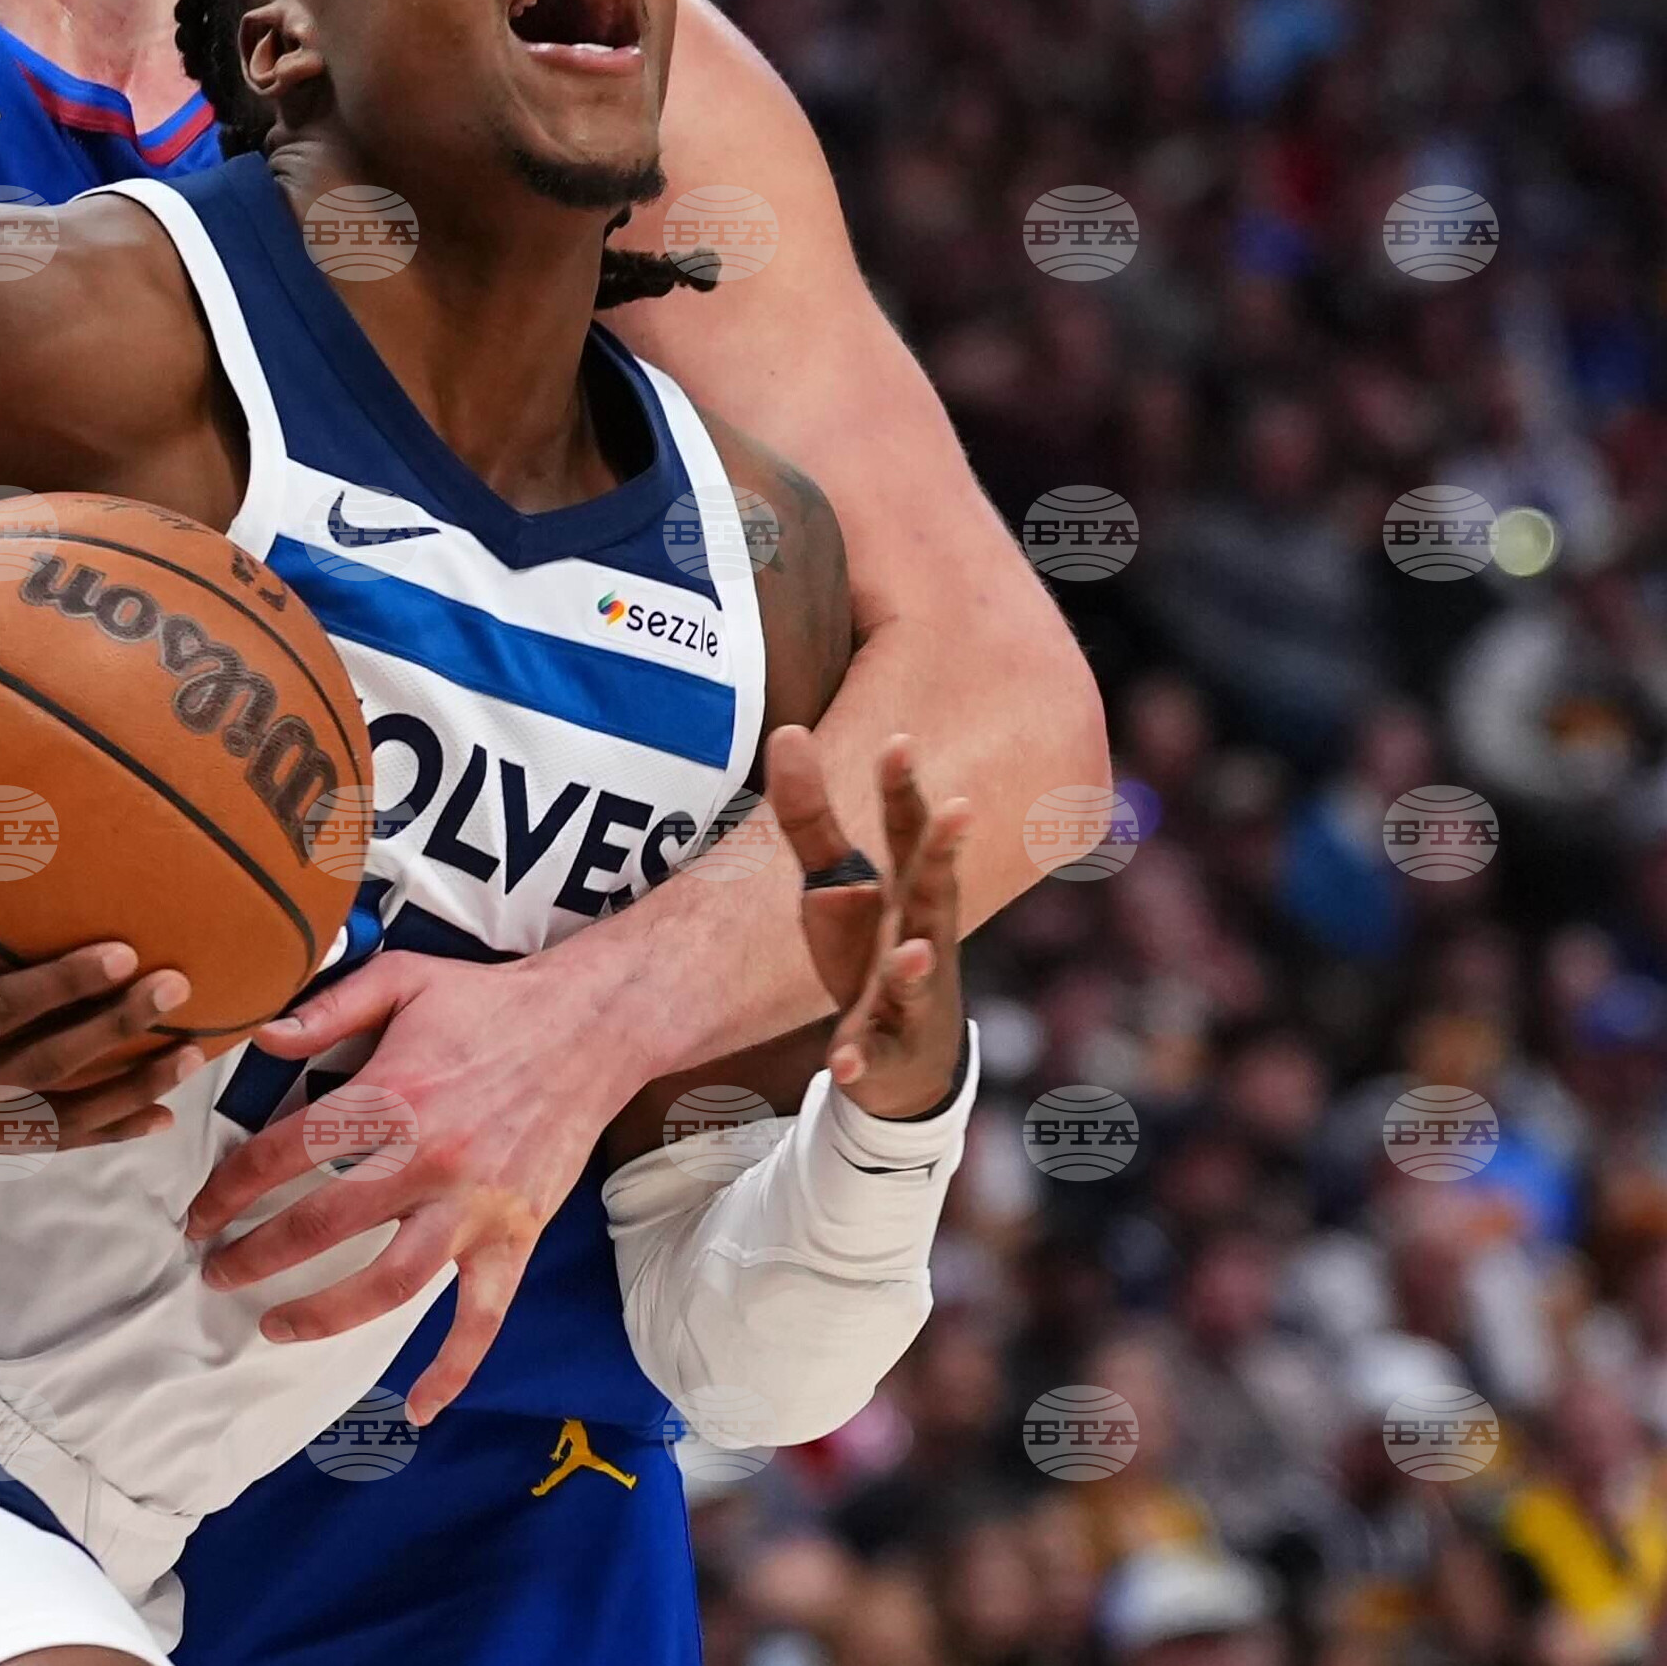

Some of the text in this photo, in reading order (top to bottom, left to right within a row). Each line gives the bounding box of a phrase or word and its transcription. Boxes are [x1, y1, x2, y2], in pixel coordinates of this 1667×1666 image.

[17, 553, 338, 868] Wilson
[625, 604, 719, 658] sezzle
[363, 711, 698, 917] OLVES
